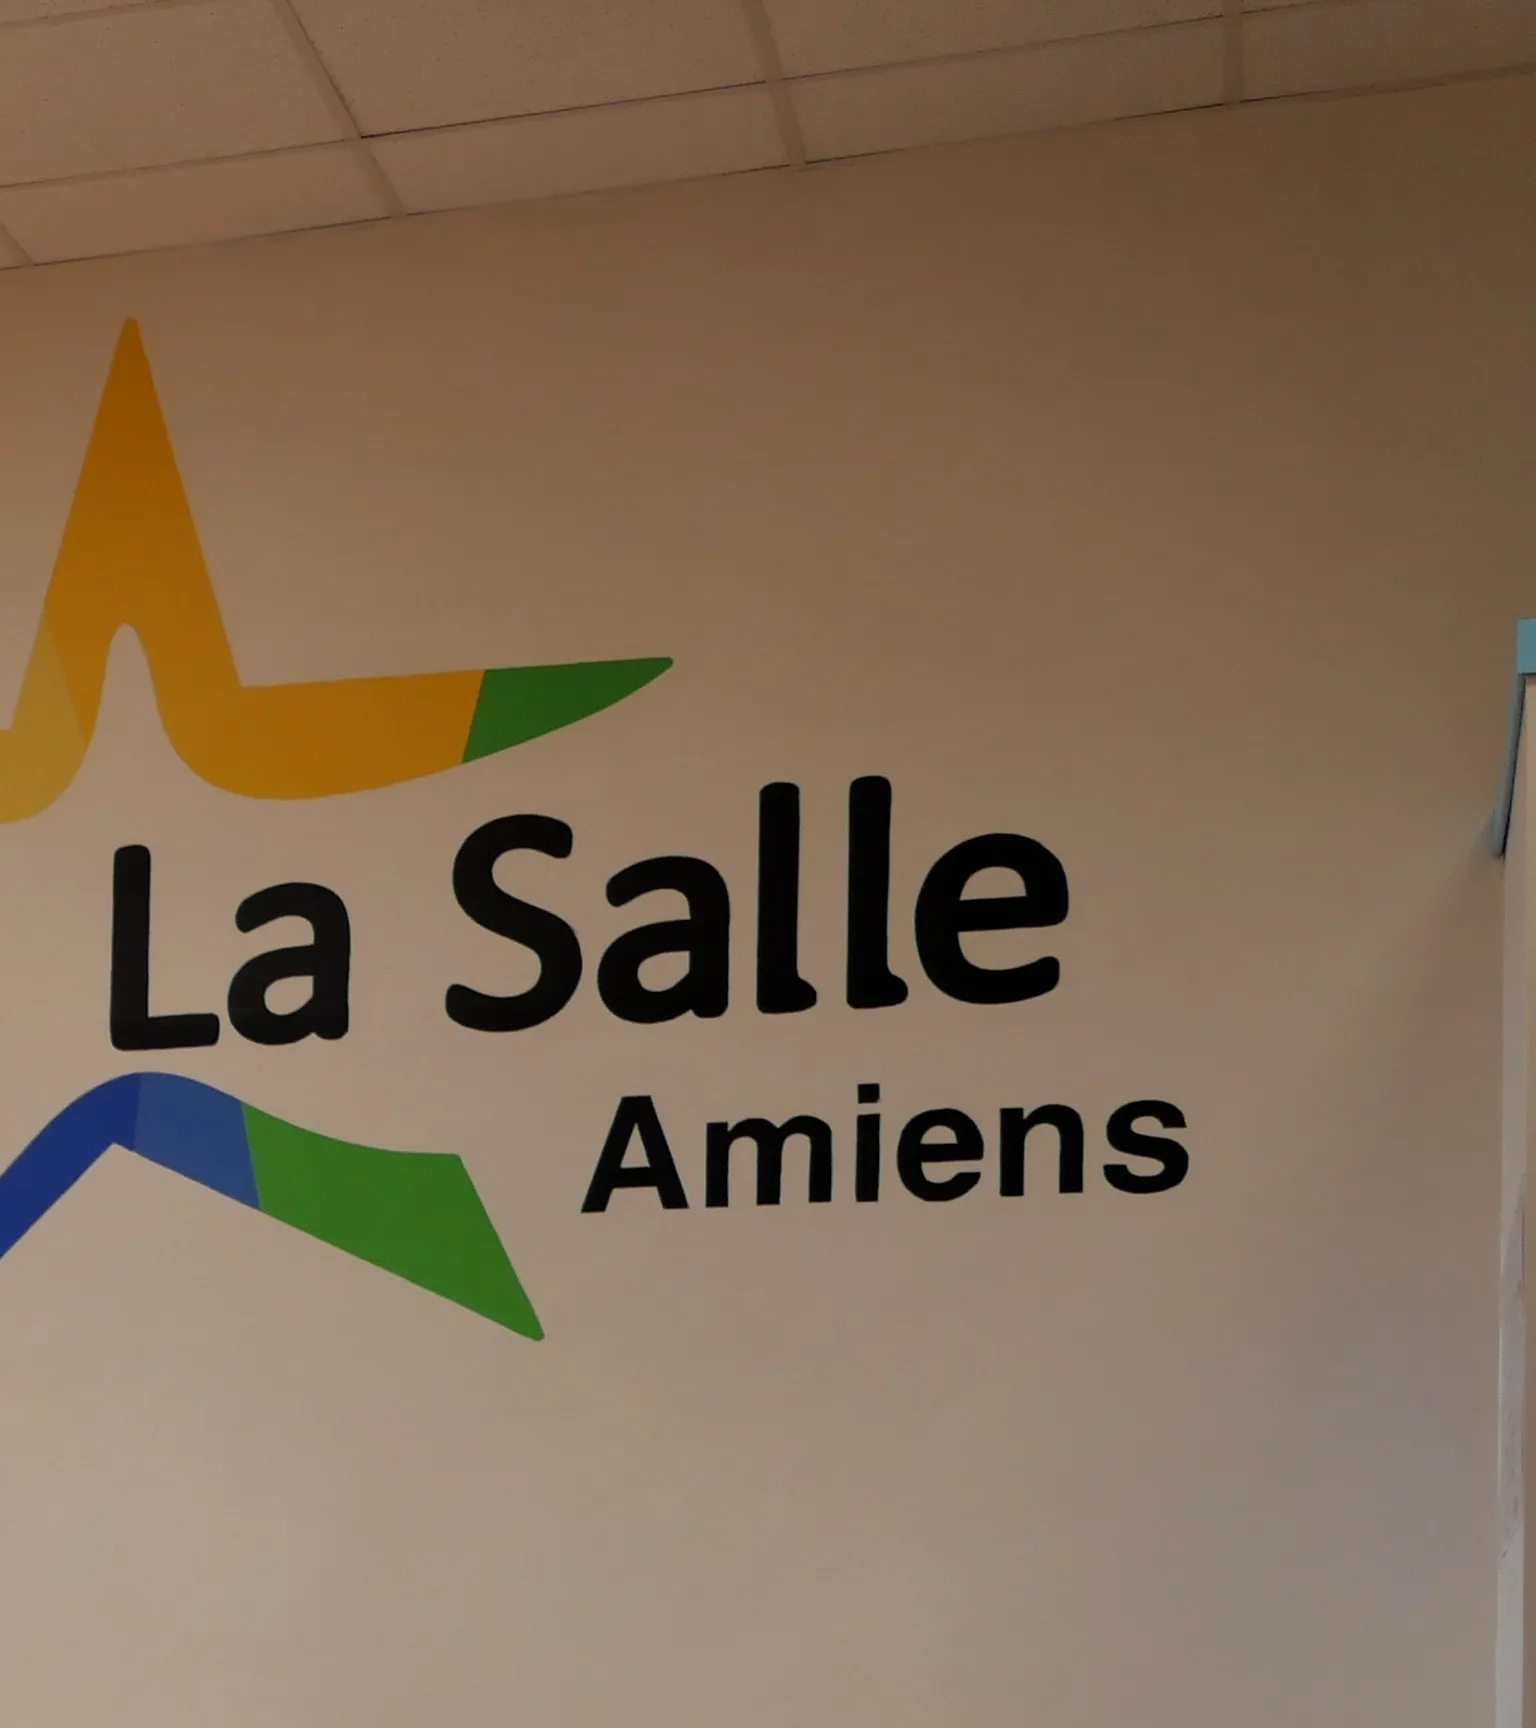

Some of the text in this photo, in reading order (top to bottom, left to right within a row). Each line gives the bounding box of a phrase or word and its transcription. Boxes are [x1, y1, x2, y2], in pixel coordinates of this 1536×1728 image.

[109, 774, 1070, 1052] La Salle
[580, 1082, 1191, 1214] Amiens
